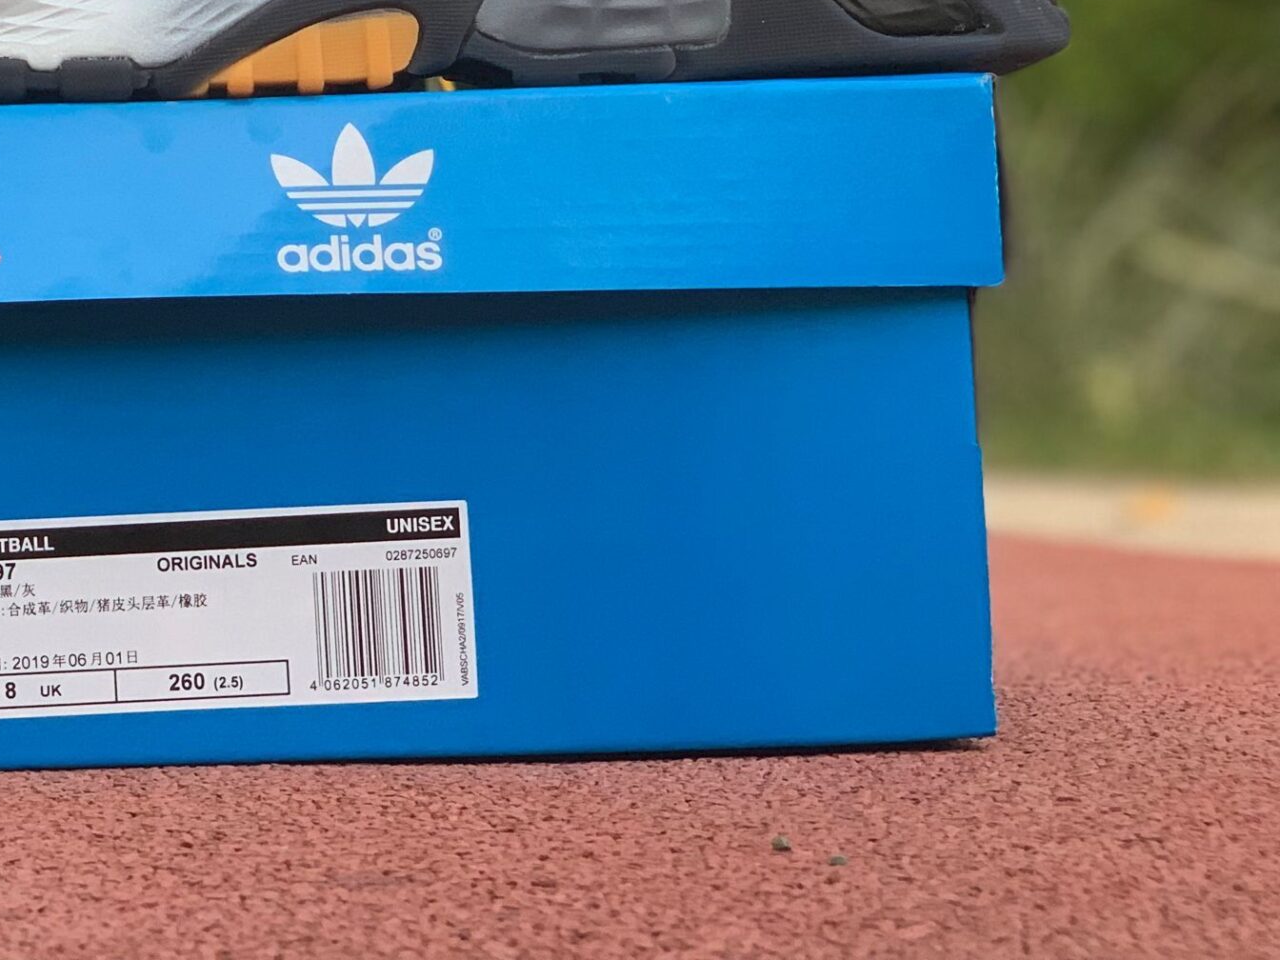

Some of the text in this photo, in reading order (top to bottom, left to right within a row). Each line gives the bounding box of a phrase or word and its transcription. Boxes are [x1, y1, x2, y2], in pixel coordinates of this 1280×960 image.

[277, 234, 443, 273] adidas
[386, 515, 454, 533] UNISEX
[157, 553, 257, 572] ORIGINALS
[291, 555, 318, 566] EAN
[385, 547, 458, 561] 0287250697
[4, 682, 62, 699] 8 UK
[169, 672, 244, 691] 260 (2.5)
